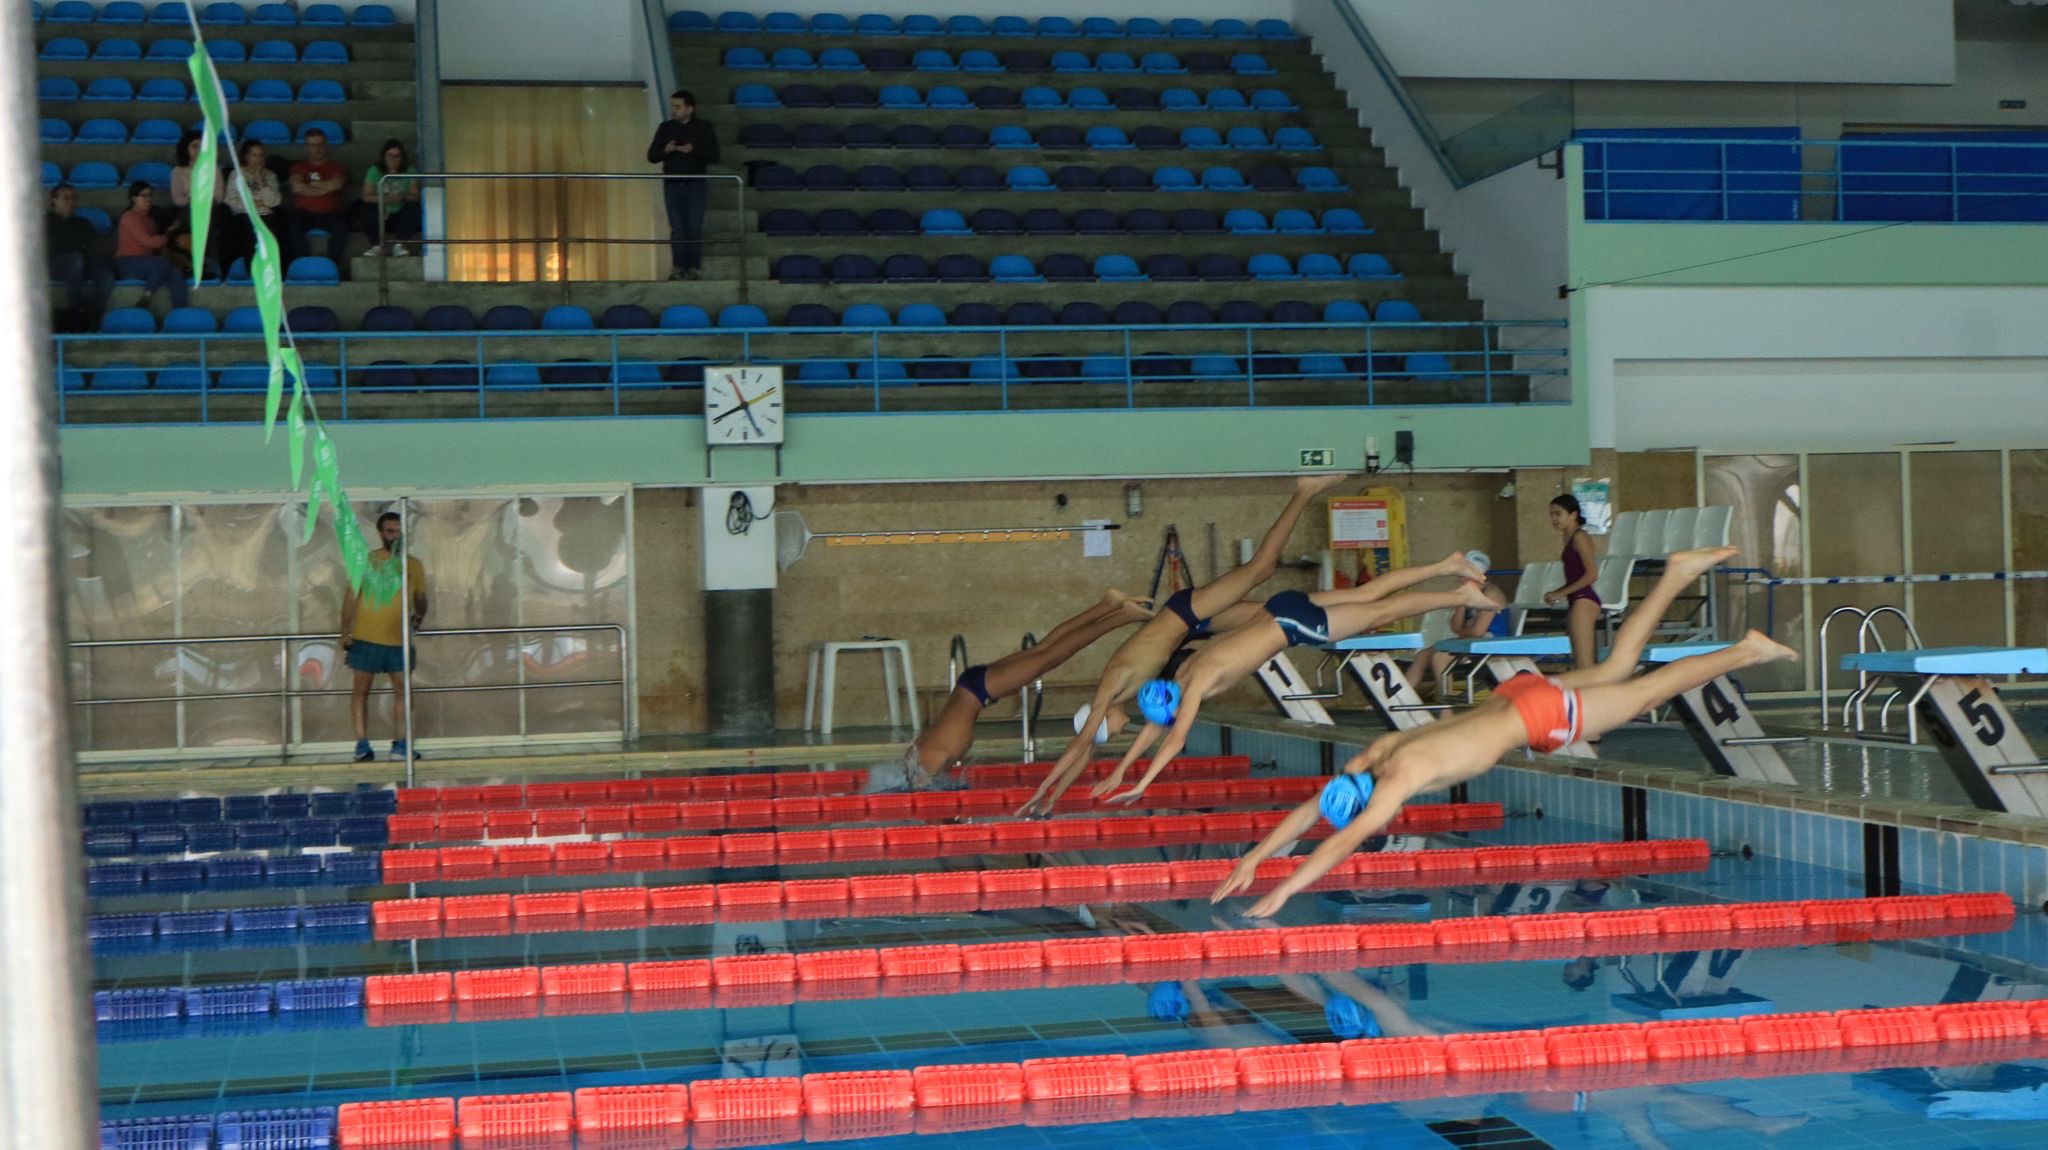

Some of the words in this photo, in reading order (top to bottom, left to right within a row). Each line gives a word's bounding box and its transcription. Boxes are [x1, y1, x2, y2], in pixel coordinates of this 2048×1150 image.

[1268, 659, 1292, 688] 1
[1371, 662, 1403, 699] 2
[1702, 680, 1740, 727] 4
[1957, 687, 2006, 747] 5
